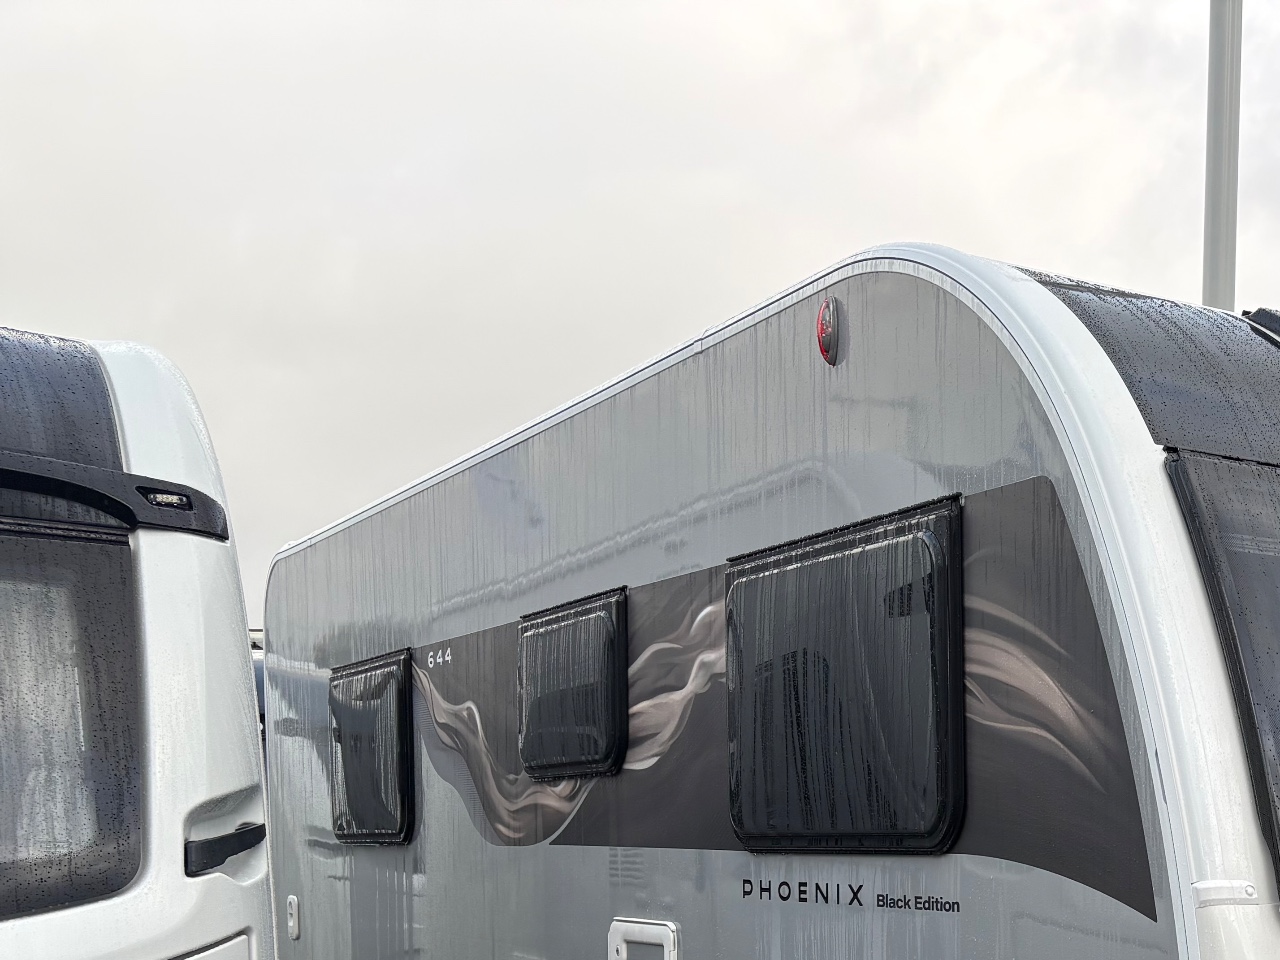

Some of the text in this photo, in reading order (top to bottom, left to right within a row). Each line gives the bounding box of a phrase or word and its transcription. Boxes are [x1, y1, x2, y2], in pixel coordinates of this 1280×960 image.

[427, 647, 452, 669] 644
[742, 879, 960, 913] PHOENIX Black Edition
